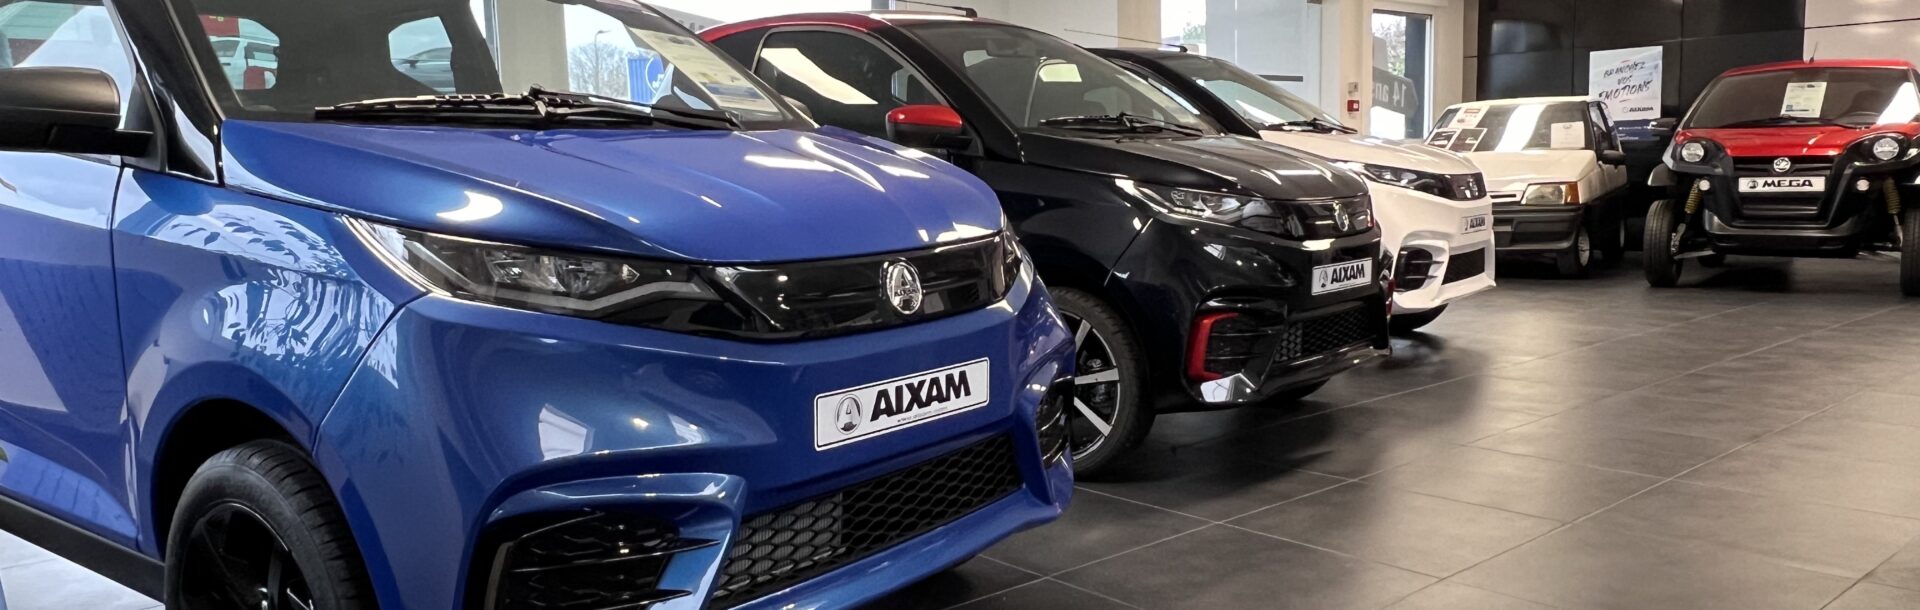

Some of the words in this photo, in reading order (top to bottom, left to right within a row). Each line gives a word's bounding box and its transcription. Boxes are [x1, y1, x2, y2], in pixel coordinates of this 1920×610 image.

[1617, 75, 1632, 86] VOS
[1762, 180, 1813, 188] MEGA
[1330, 263, 1365, 285] AIXAM
[870, 369, 972, 422] AIXAM
